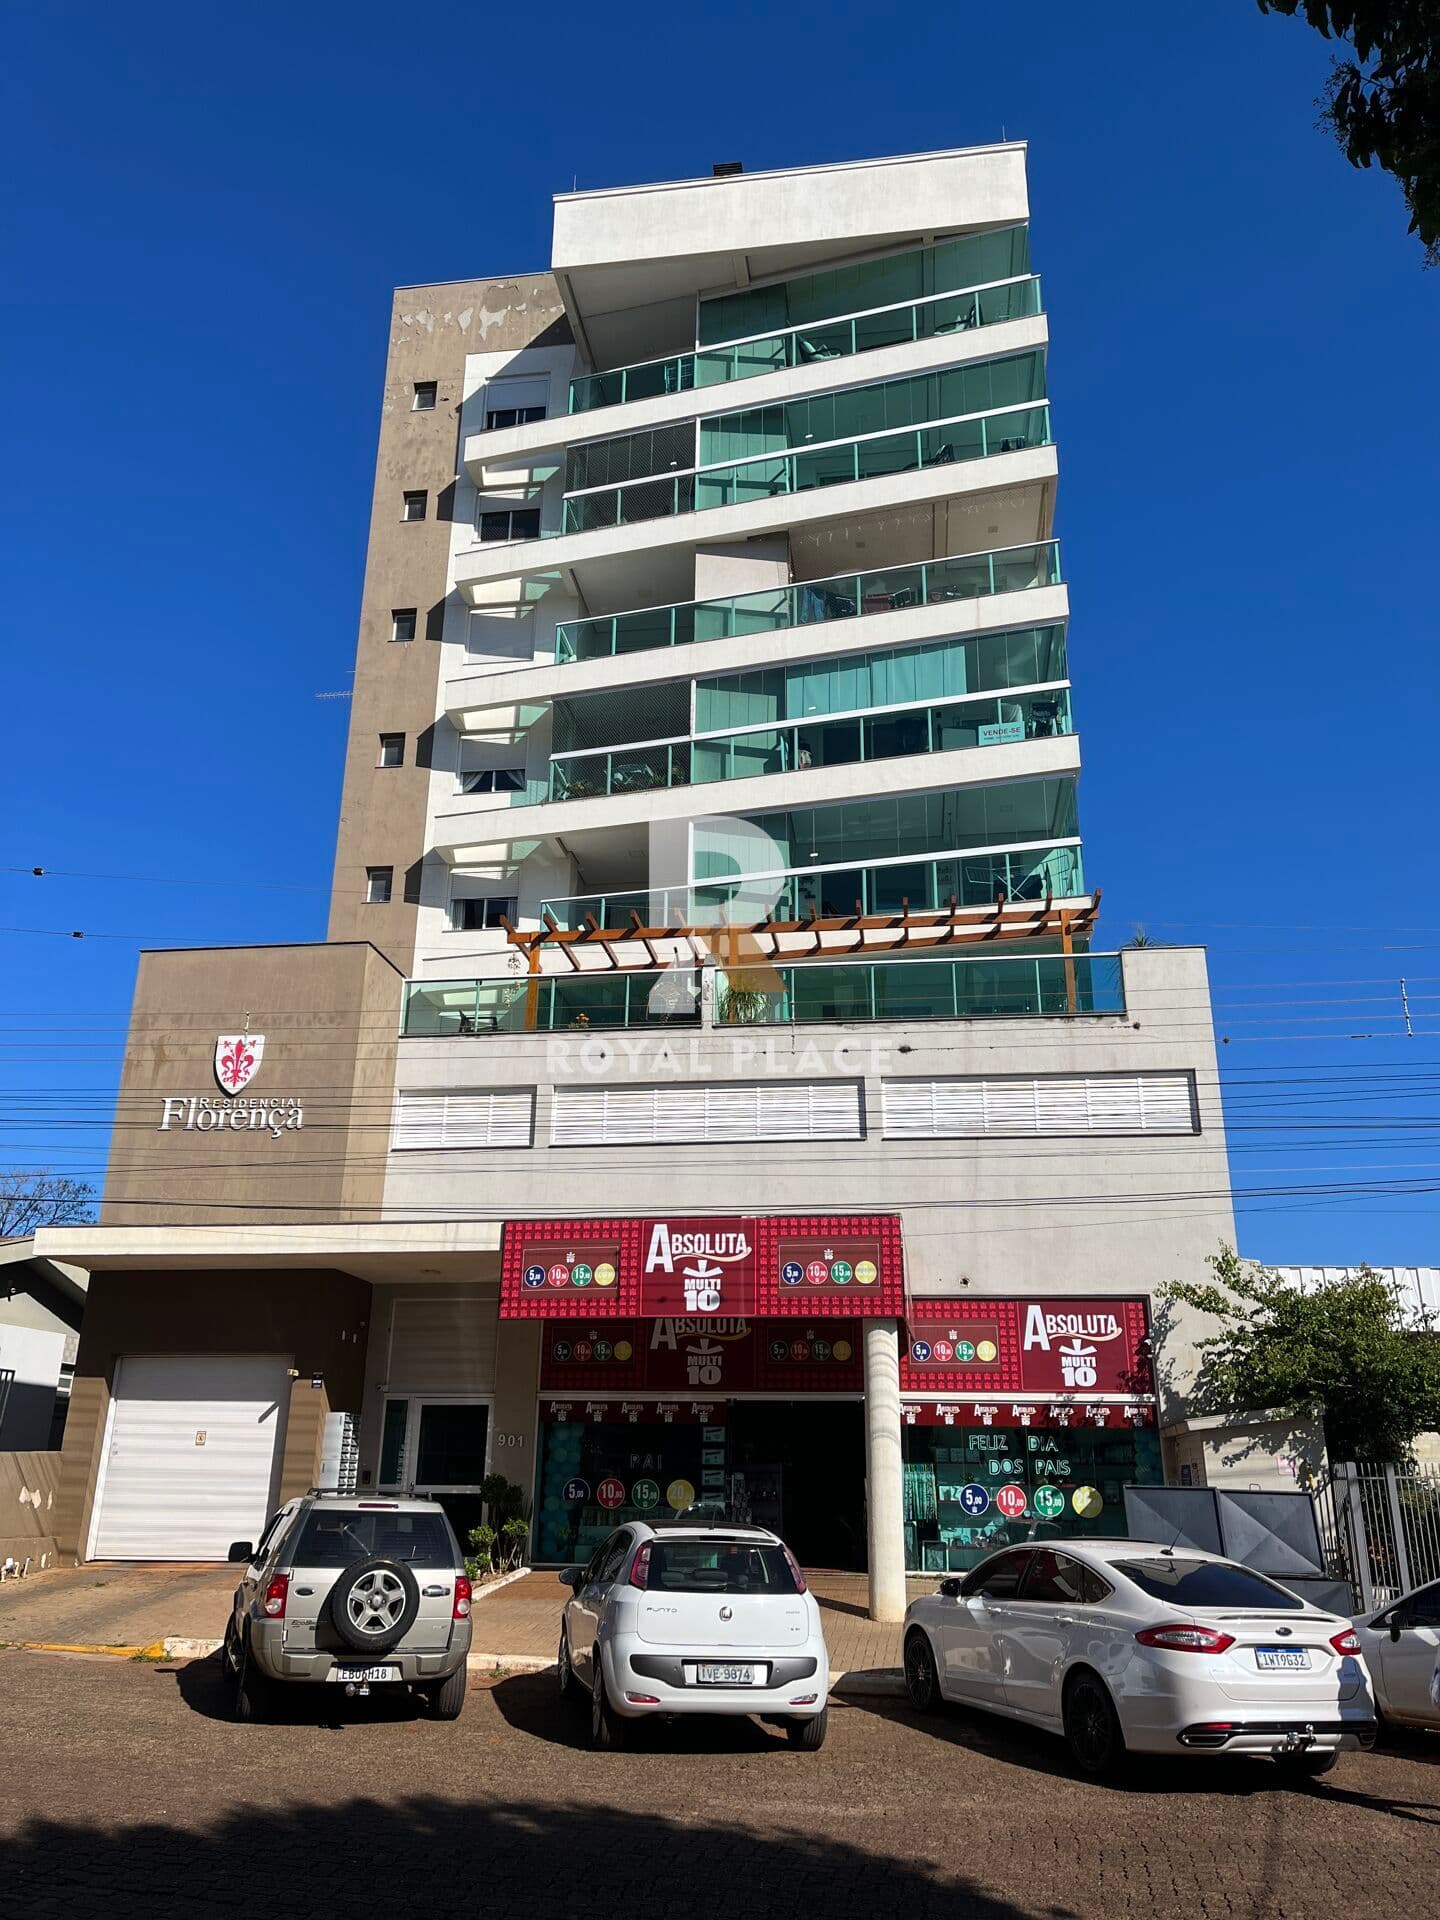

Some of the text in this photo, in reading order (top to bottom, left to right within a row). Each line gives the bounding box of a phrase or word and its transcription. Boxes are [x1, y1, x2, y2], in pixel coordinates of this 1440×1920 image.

[984, 727, 1021, 736] VENDE-SE
[200, 1097, 303, 1108] RESIDENCIAL
[157, 1096, 304, 1139] Florença
[645, 1224, 748, 1273] ABSOLUTA
[684, 1278, 721, 1290] MULTI
[684, 1289, 720, 1311] 10
[1023, 1304, 1119, 1350] ABSOLUTA
[1061, 1356, 1097, 1368] MULTI
[687, 1366, 722, 1385] 10
[1062, 1367, 1097, 1387] 10
[498, 1434, 523, 1447] 901
[968, 1434, 1059, 1452] FELIZ DIA
[988, 1458, 1072, 1476] DOS PAIS
[965, 1489, 982, 1505] 5,00
[1000, 1490, 1024, 1507] 10,00
[1038, 1491, 1062, 1507] 15,00
